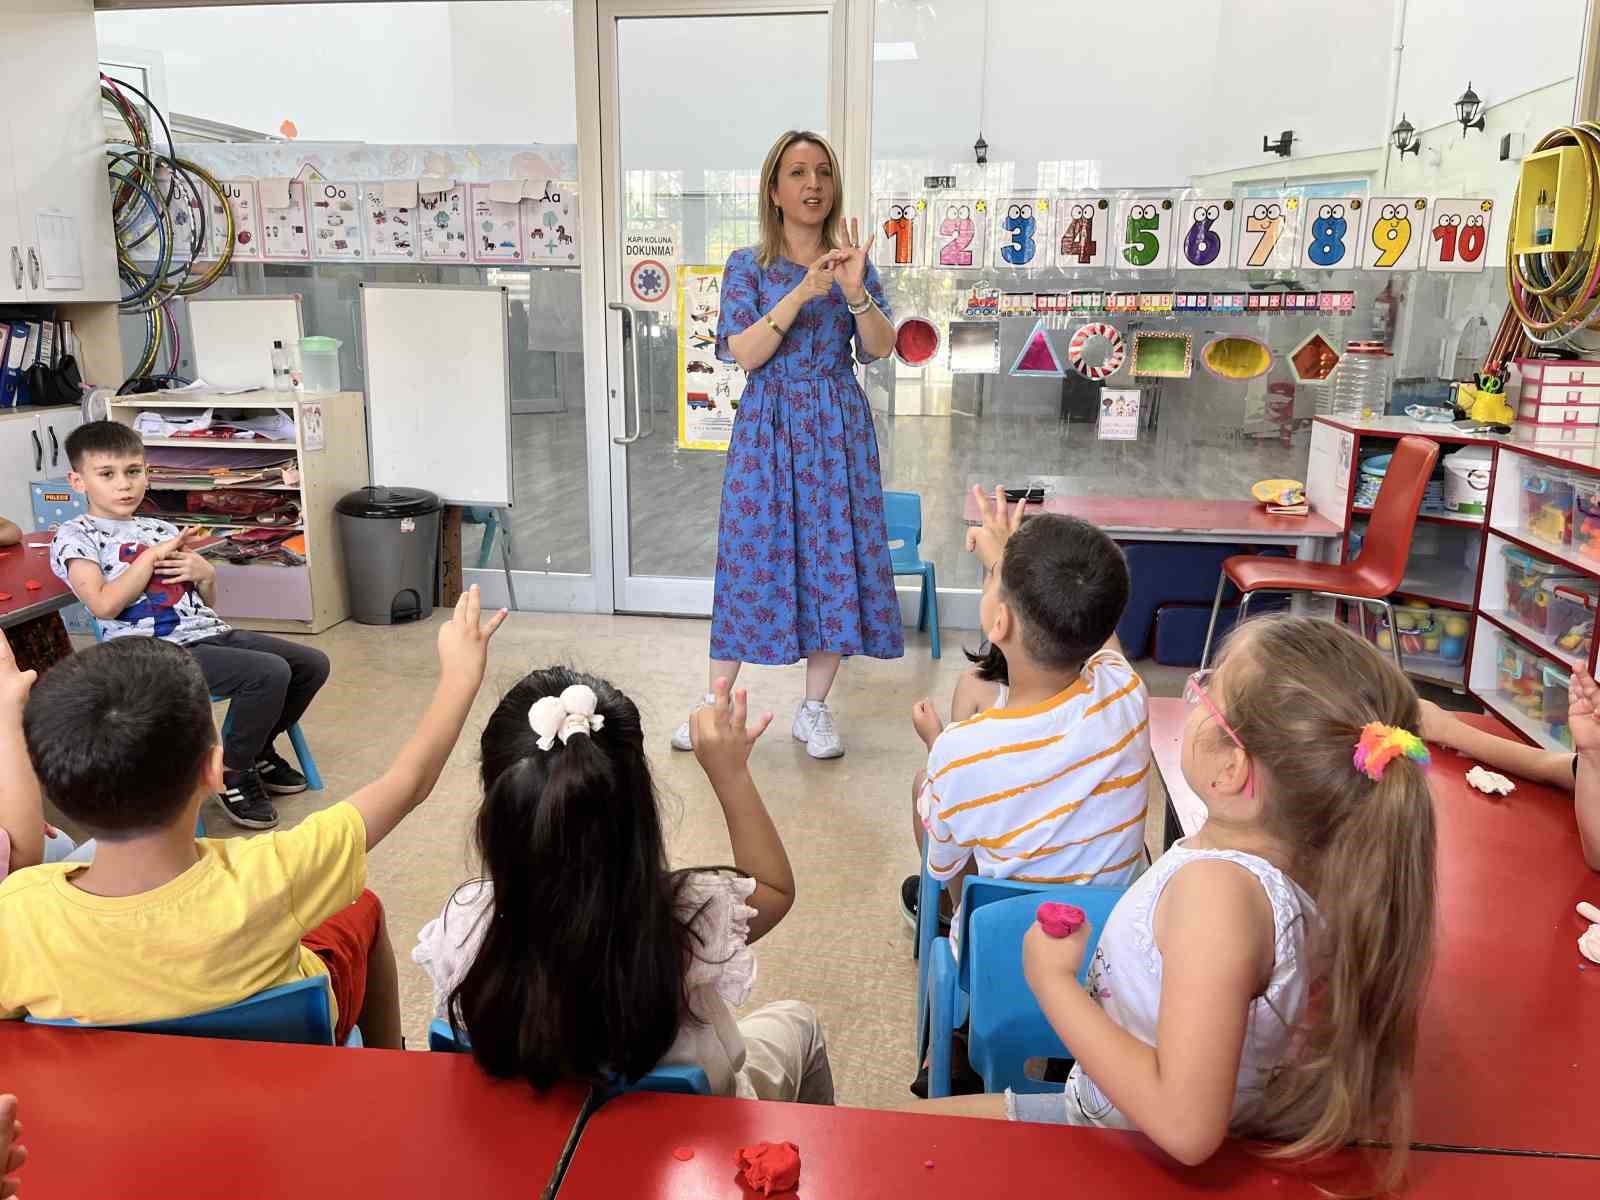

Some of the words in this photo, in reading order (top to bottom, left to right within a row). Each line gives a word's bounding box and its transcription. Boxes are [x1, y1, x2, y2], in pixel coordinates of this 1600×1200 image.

[222, 183, 241, 199] Uu
[324, 184, 346, 199] Oo
[540, 189, 560, 203] Aa
[626, 245, 674, 257] DOKUNMA!
[627, 236, 643, 245] KAPI
[645, 236, 673, 245] KOLUNA
[882, 218, 913, 264] 1
[939, 217, 975, 265] 2
[1000, 216, 1037, 265] 3
[1061, 217, 1097, 264] 4
[1122, 213, 1160, 266] 5
[1184, 217, 1221, 266] 6
[1246, 214, 1286, 266] 7
[1307, 216, 1348, 266] 8
[1371, 216, 1412, 267] 9
[1432, 224, 1486, 263] 10
